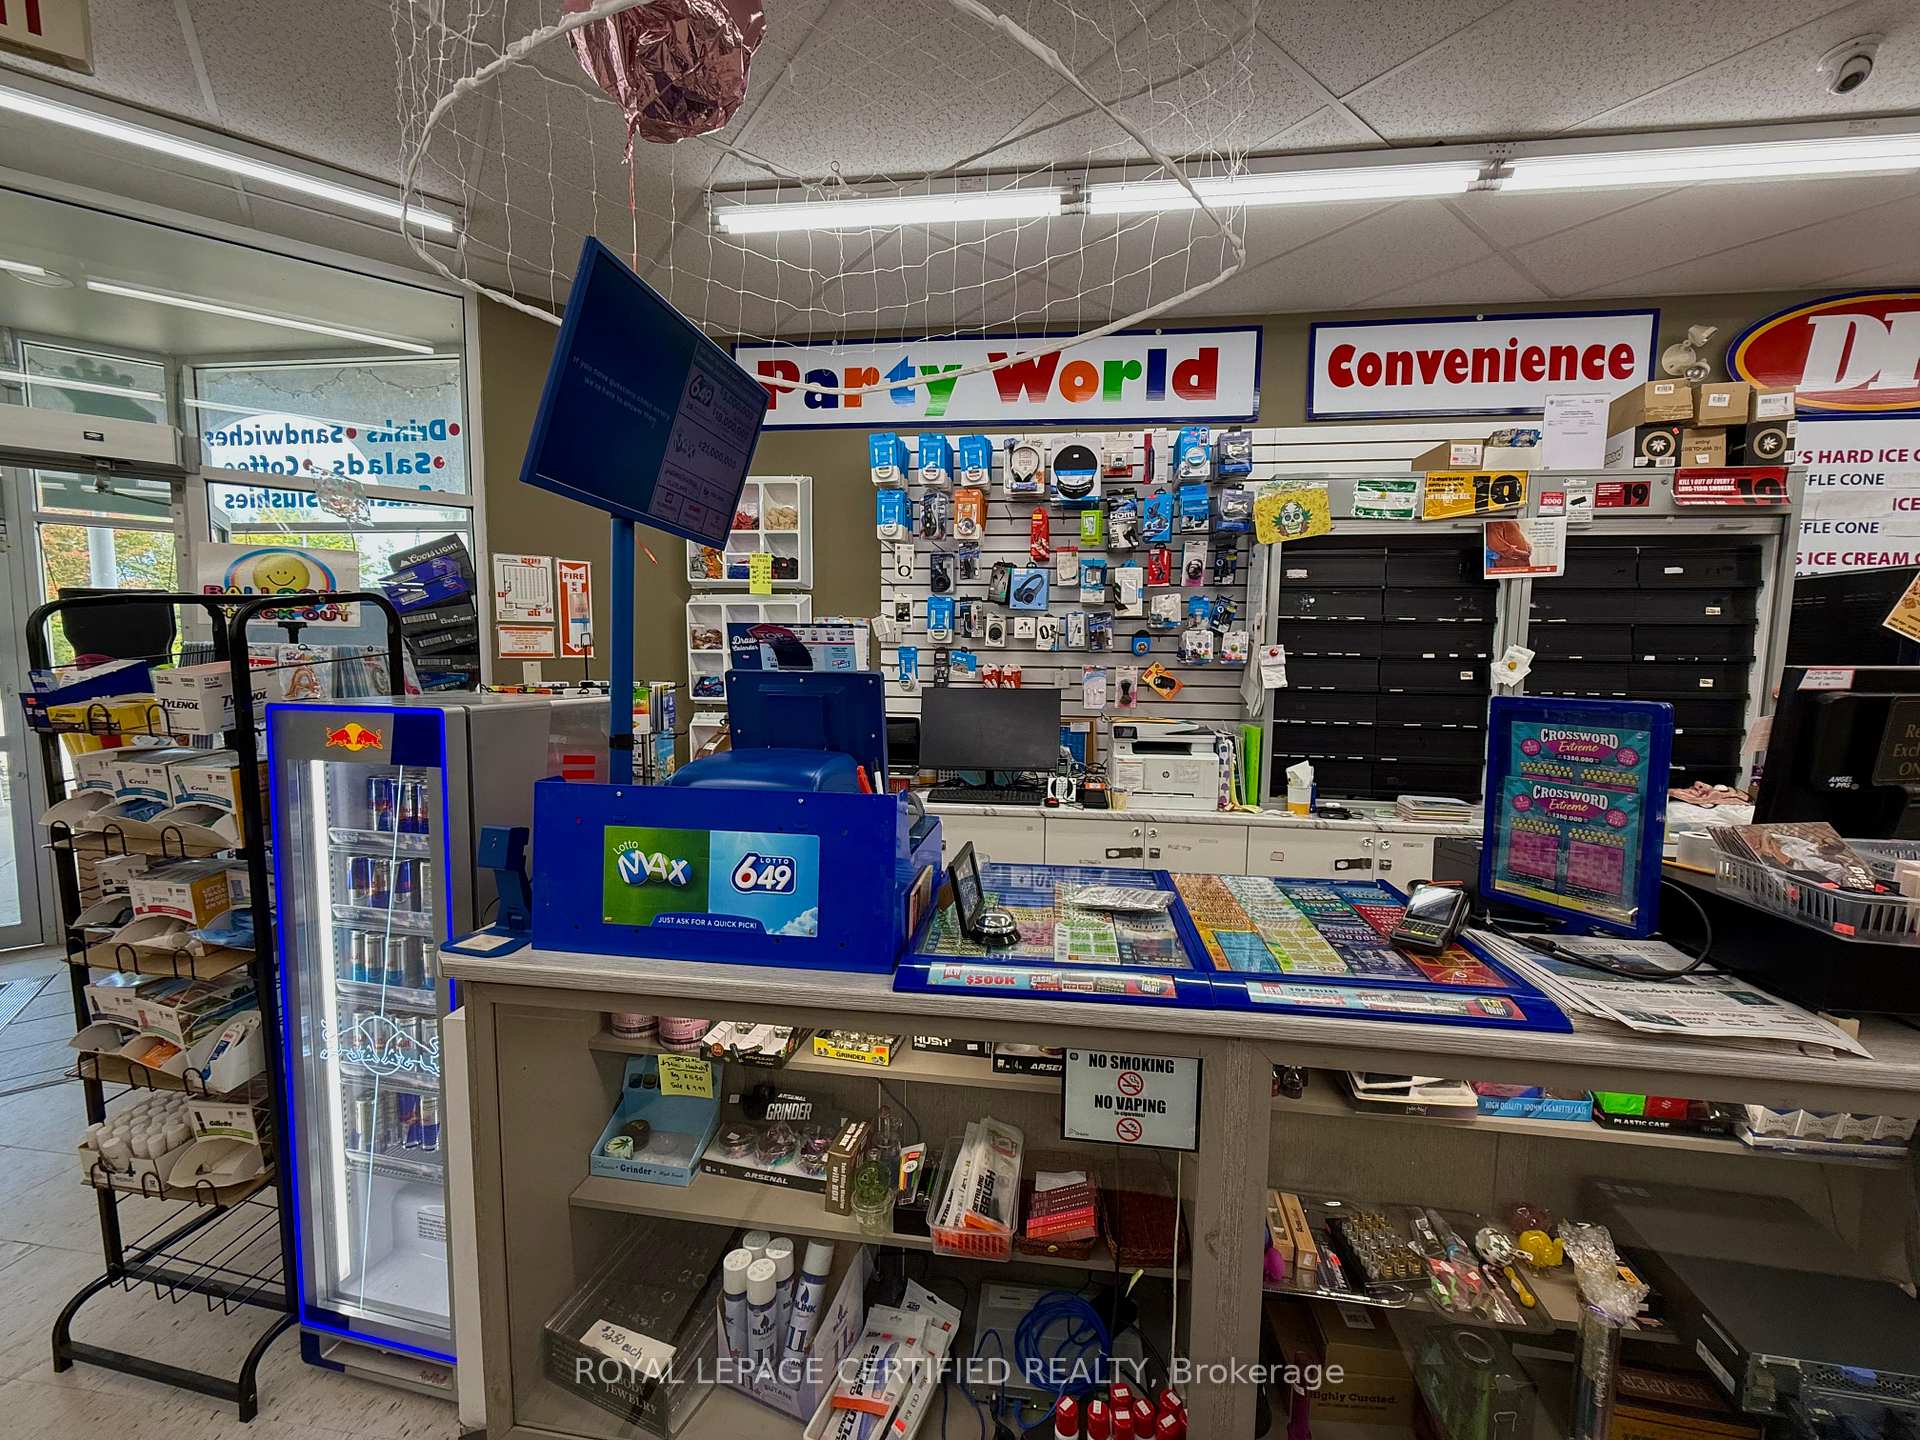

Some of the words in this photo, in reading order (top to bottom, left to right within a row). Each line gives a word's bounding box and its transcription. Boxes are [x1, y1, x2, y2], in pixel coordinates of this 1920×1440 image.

[1327, 336, 1635, 388] Convenience
[757, 353, 963, 416] Party
[987, 346, 1219, 403] World
[1818, 450, 1873, 464] HARD
[1879, 449, 1909, 463] ICE
[1840, 473, 1884, 486] CONE
[1623, 484, 1648, 505] 19
[1835, 522, 1879, 534] CONE
[1808, 552, 1836, 565] ICE
[1842, 552, 1909, 566] CREAM
[564, 572, 584, 580] FIRE
[302, 609, 352, 622] OUT
[161, 697, 199, 711] TYLENOL
[1540, 728, 1619, 750] CROSSWORD
[1558, 742, 1600, 753] Extreme
[1532, 785, 1609, 811] CROSSWORD
[1548, 799, 1589, 812] Extreme
[613, 840, 639, 855] Lotto
[617, 850, 689, 885] MAX
[760, 857, 789, 865] LOTTO
[734, 856, 792, 890] 649
[658, 916, 675, 924] JUST
[676, 917, 690, 925] ASK
[691, 918, 706, 926] FOR
[707, 918, 713, 926] A
[713, 919, 737, 928] QUICK
[738, 920, 757, 929] PICK!
[965, 973, 1016, 986] $500K
[914, 1035, 950, 1047] HUSH
[836, 1051, 866, 1061] GRINDER
[1089, 1053, 1107, 1068] NO
[1110, 1055, 1175, 1074] SMOKING
[778, 1093, 807, 1101] ARSENAL
[1094, 1095, 1112, 1109] NO
[1116, 1096, 1167, 1114] VAPING
[1485, 1101, 1499, 1110] HIGH
[765, 1103, 813, 1121] GRINDER
[1614, 1117, 1646, 1127] PLASTIC
[1648, 1120, 1671, 1128] CASE
[620, 1162, 653, 1175] Grinder
[743, 1171, 789, 1185] ARSENAL
[622, 1344, 643, 1360] each
[605, 1383, 657, 1415] JEWELRY
[1309, 1391, 1346, 1402] Highly
